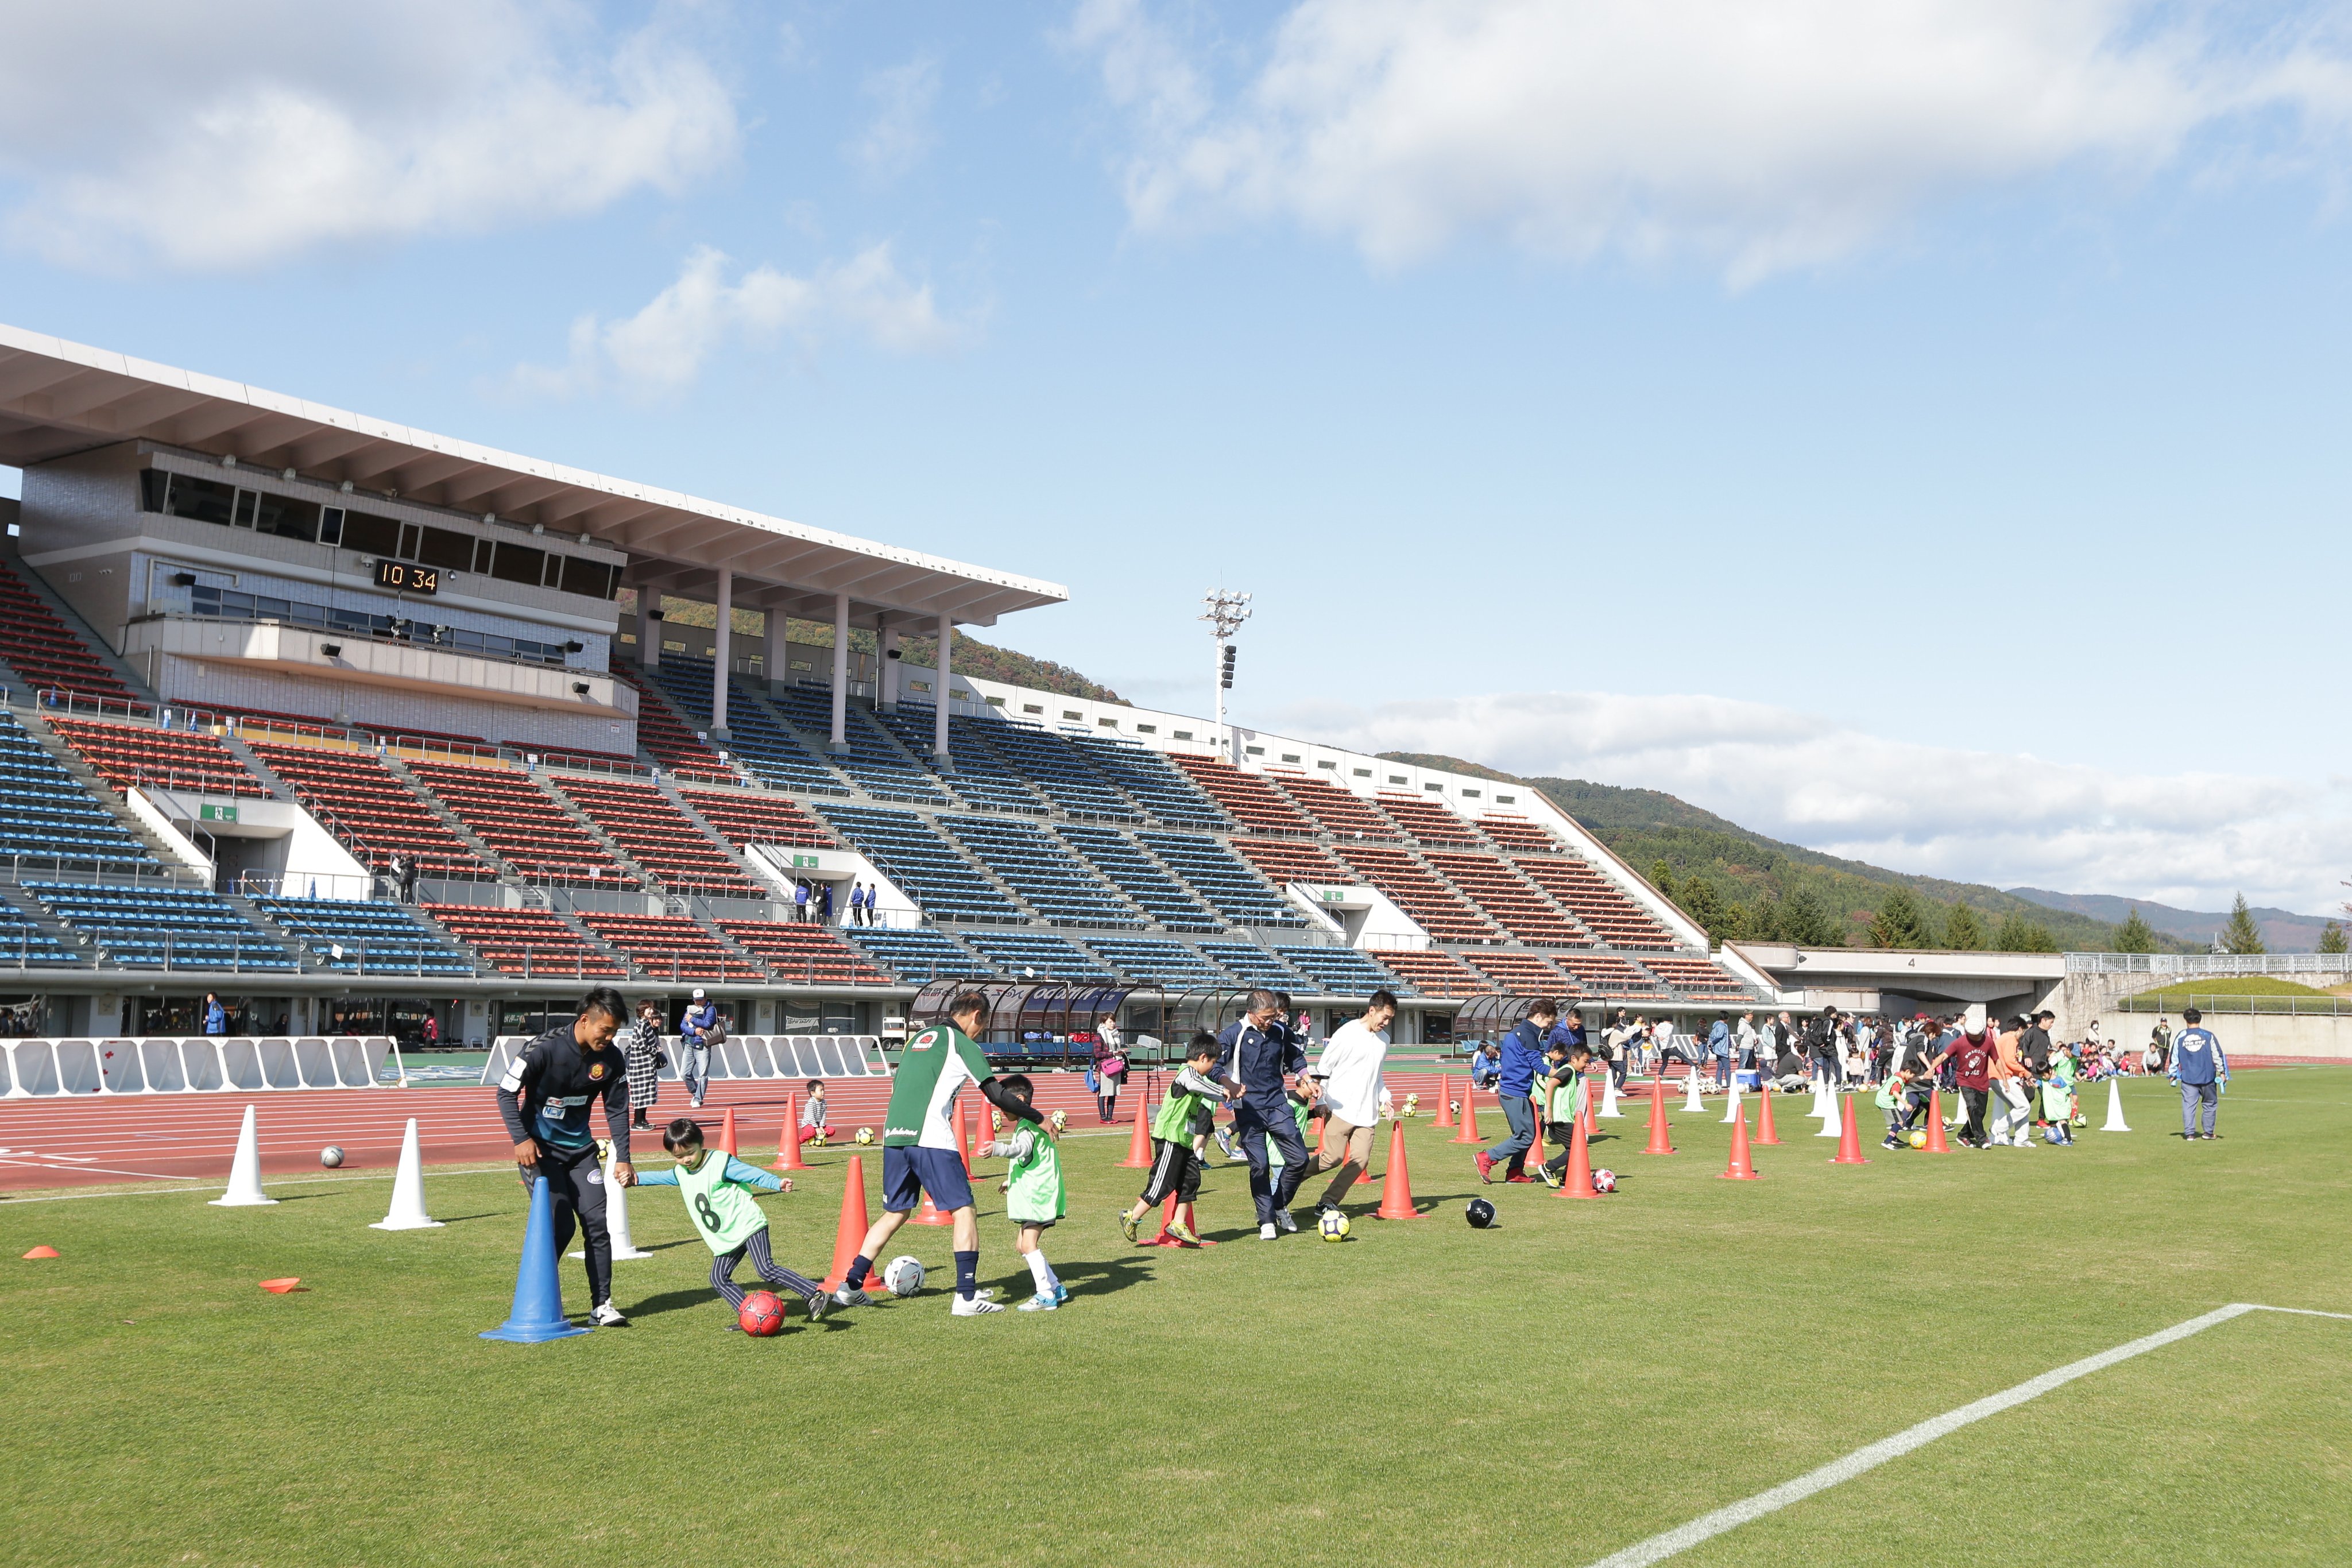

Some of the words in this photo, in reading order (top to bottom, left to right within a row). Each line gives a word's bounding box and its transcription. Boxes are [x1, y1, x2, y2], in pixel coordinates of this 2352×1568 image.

[382, 563, 403, 584] 10
[412, 569, 435, 590] 34
[1908, 958, 1916, 967] 4
[544, 1108, 564, 1117] NCV
[695, 1193, 721, 1233] 8
